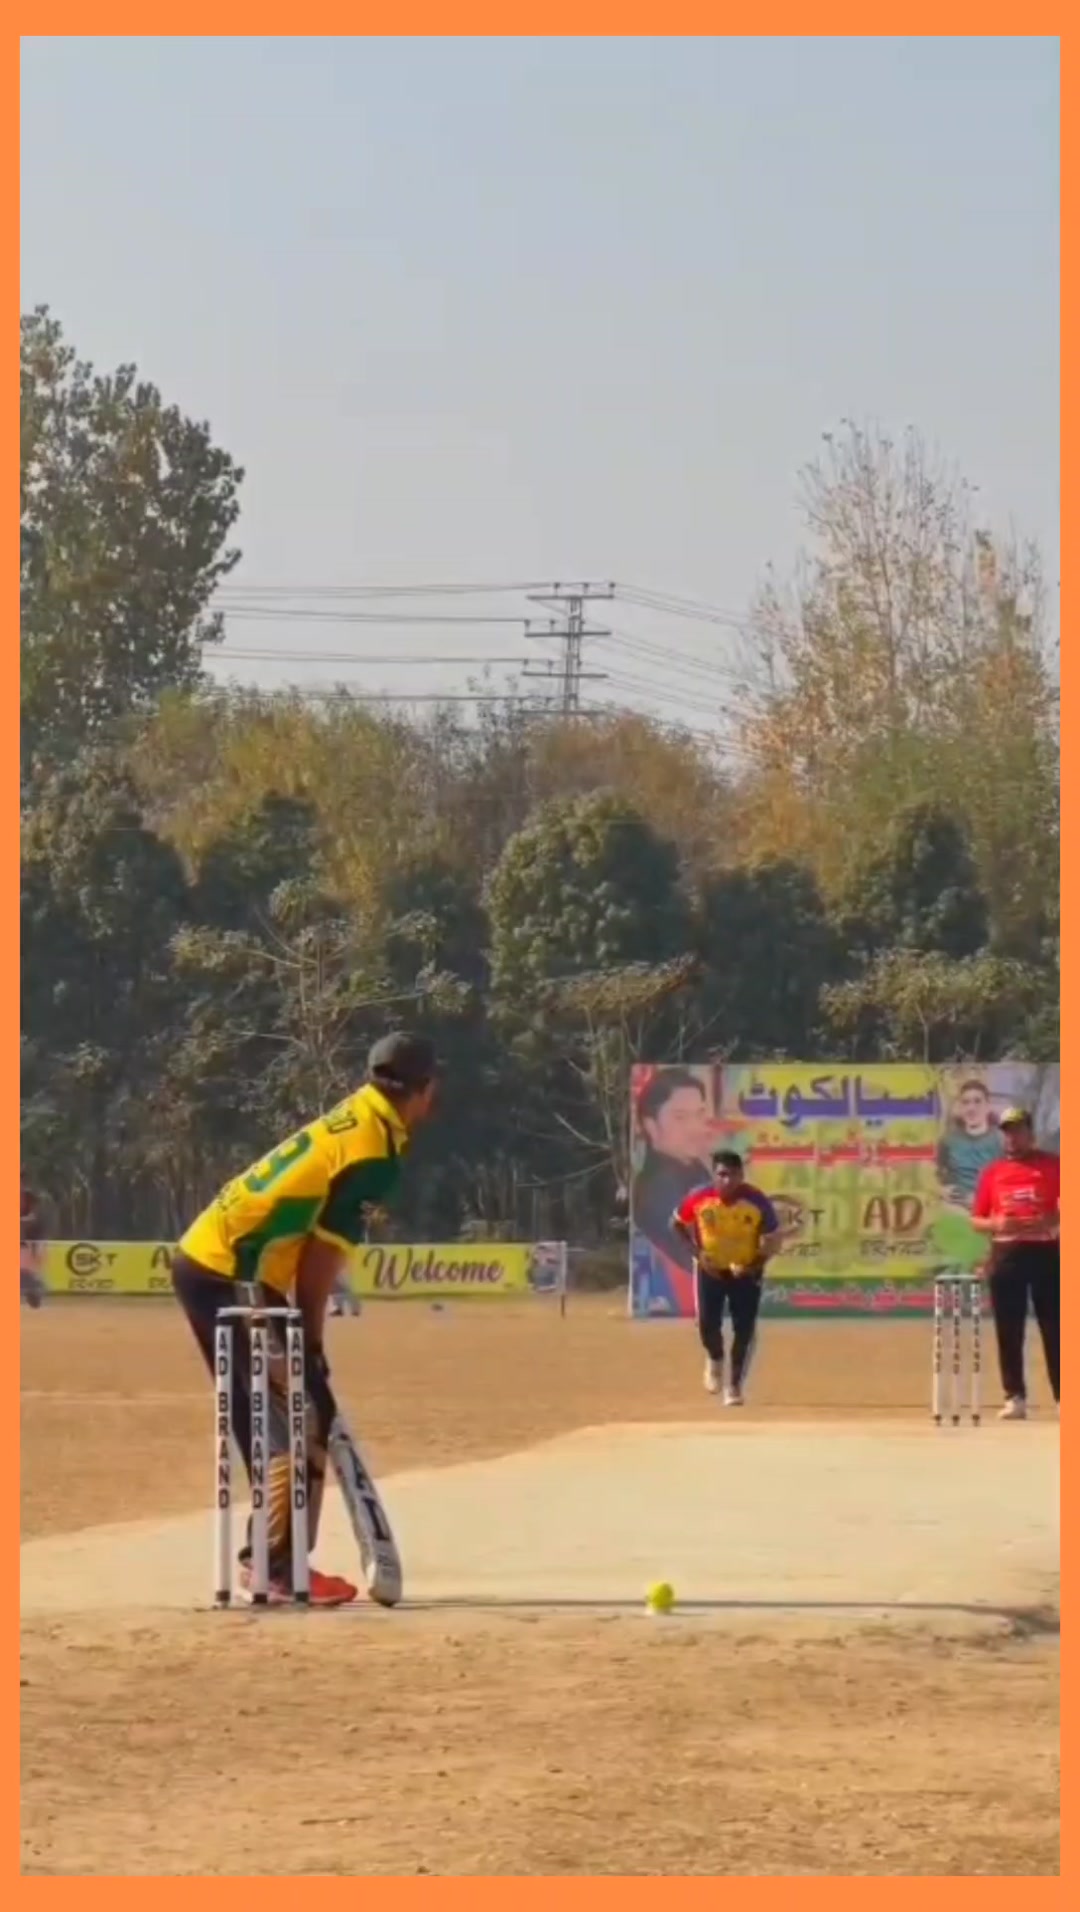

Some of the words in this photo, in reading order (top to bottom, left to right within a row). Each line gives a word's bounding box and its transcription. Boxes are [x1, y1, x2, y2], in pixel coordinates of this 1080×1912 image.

[863, 1194, 923, 1233] AD
[363, 1247, 505, 1290] Welcome
[217, 1331, 228, 1376] AD
[252, 1331, 263, 1376] AD
[291, 1331, 302, 1376] AD
[218, 1391, 230, 1509] BRAND
[251, 1392, 263, 1509] BRAND
[292, 1391, 304, 1510] BRAND
